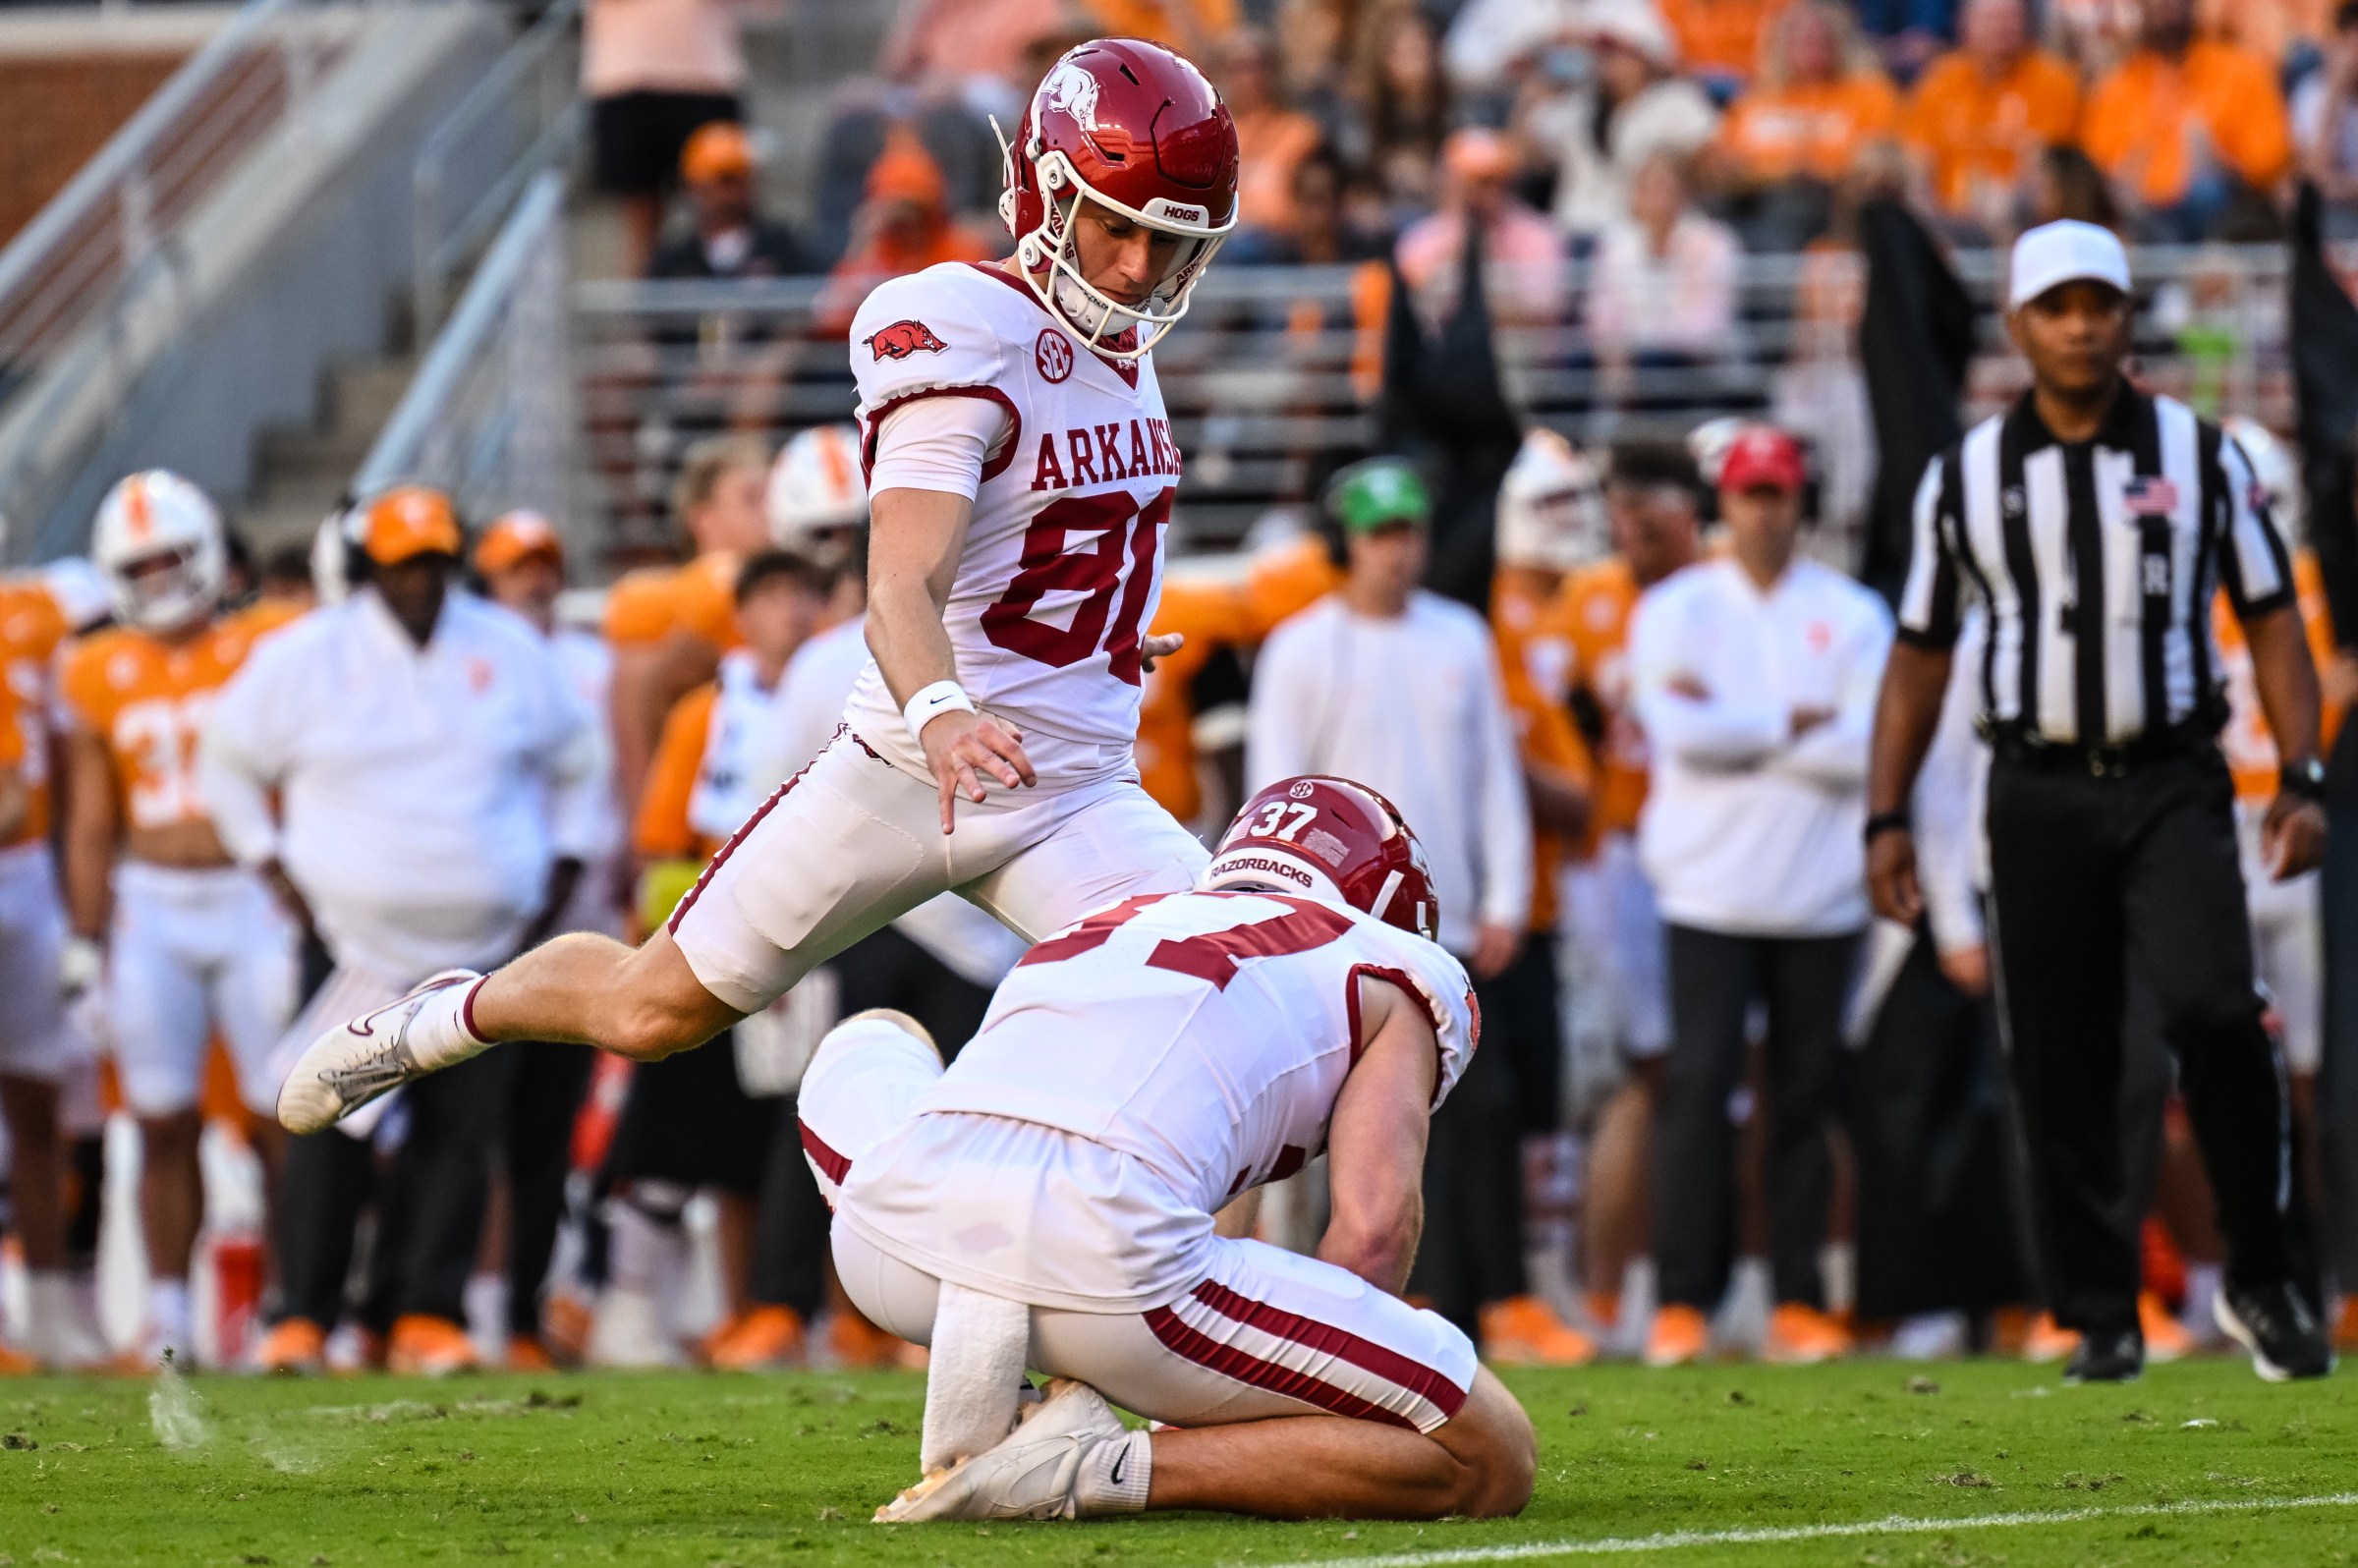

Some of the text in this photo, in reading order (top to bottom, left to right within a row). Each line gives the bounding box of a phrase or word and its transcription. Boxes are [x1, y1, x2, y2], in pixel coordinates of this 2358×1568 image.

[1163, 205, 1200, 221] HOGS
[1038, 331, 1071, 380] SEC
[1031, 418, 1182, 491] ARKANSA
[1290, 781, 1313, 798] SEC
[1250, 801, 1319, 842] 37
[1209, 858, 1314, 888] RAZORBACKS
